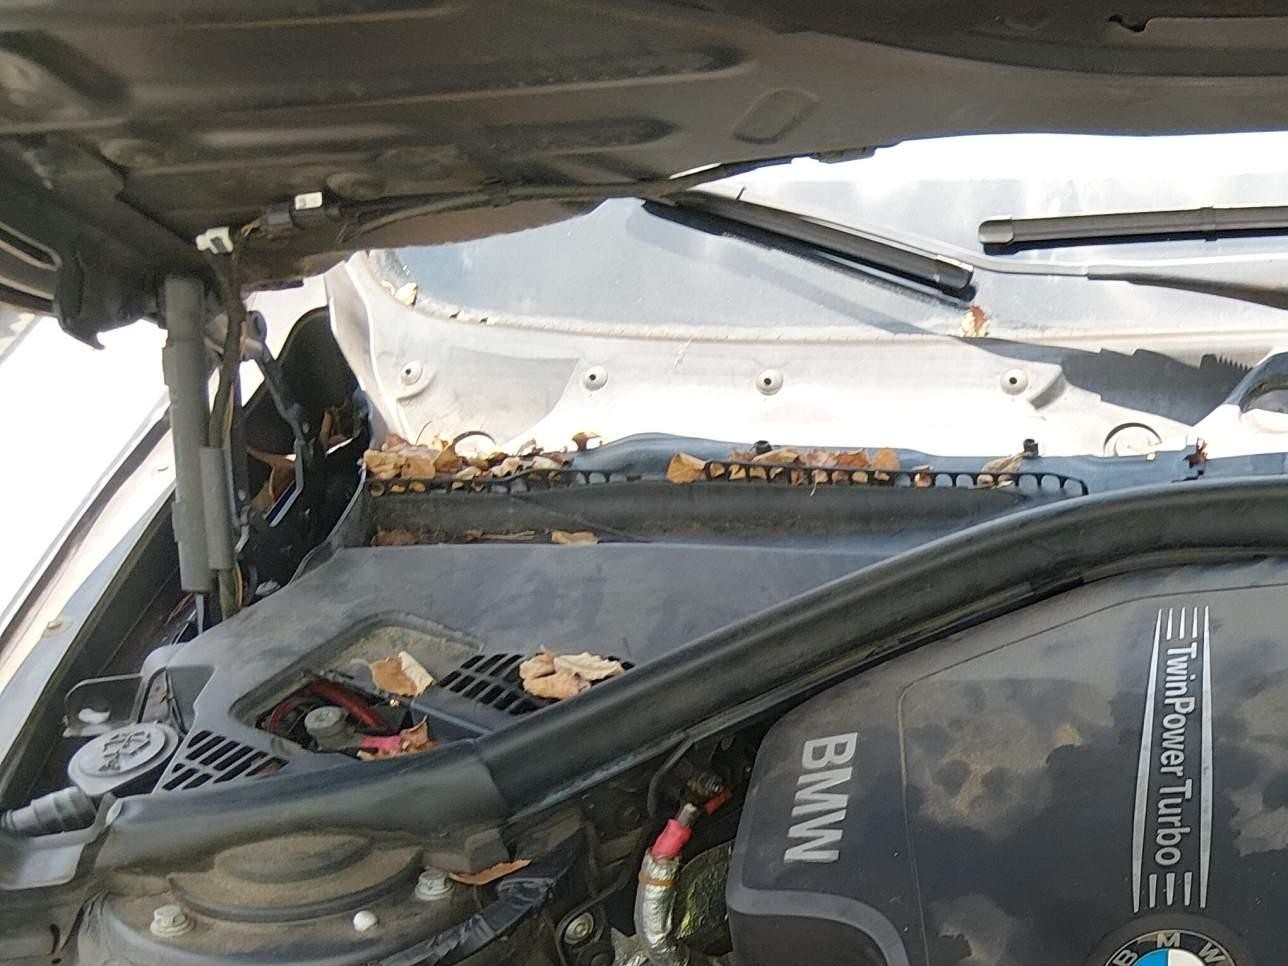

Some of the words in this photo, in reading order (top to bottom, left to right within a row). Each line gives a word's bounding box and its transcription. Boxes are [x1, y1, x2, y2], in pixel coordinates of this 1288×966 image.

[1160, 642, 1198, 777] TwinPower
[783, 731, 858, 864] BMW
[1154, 779, 1193, 866] Turbo
